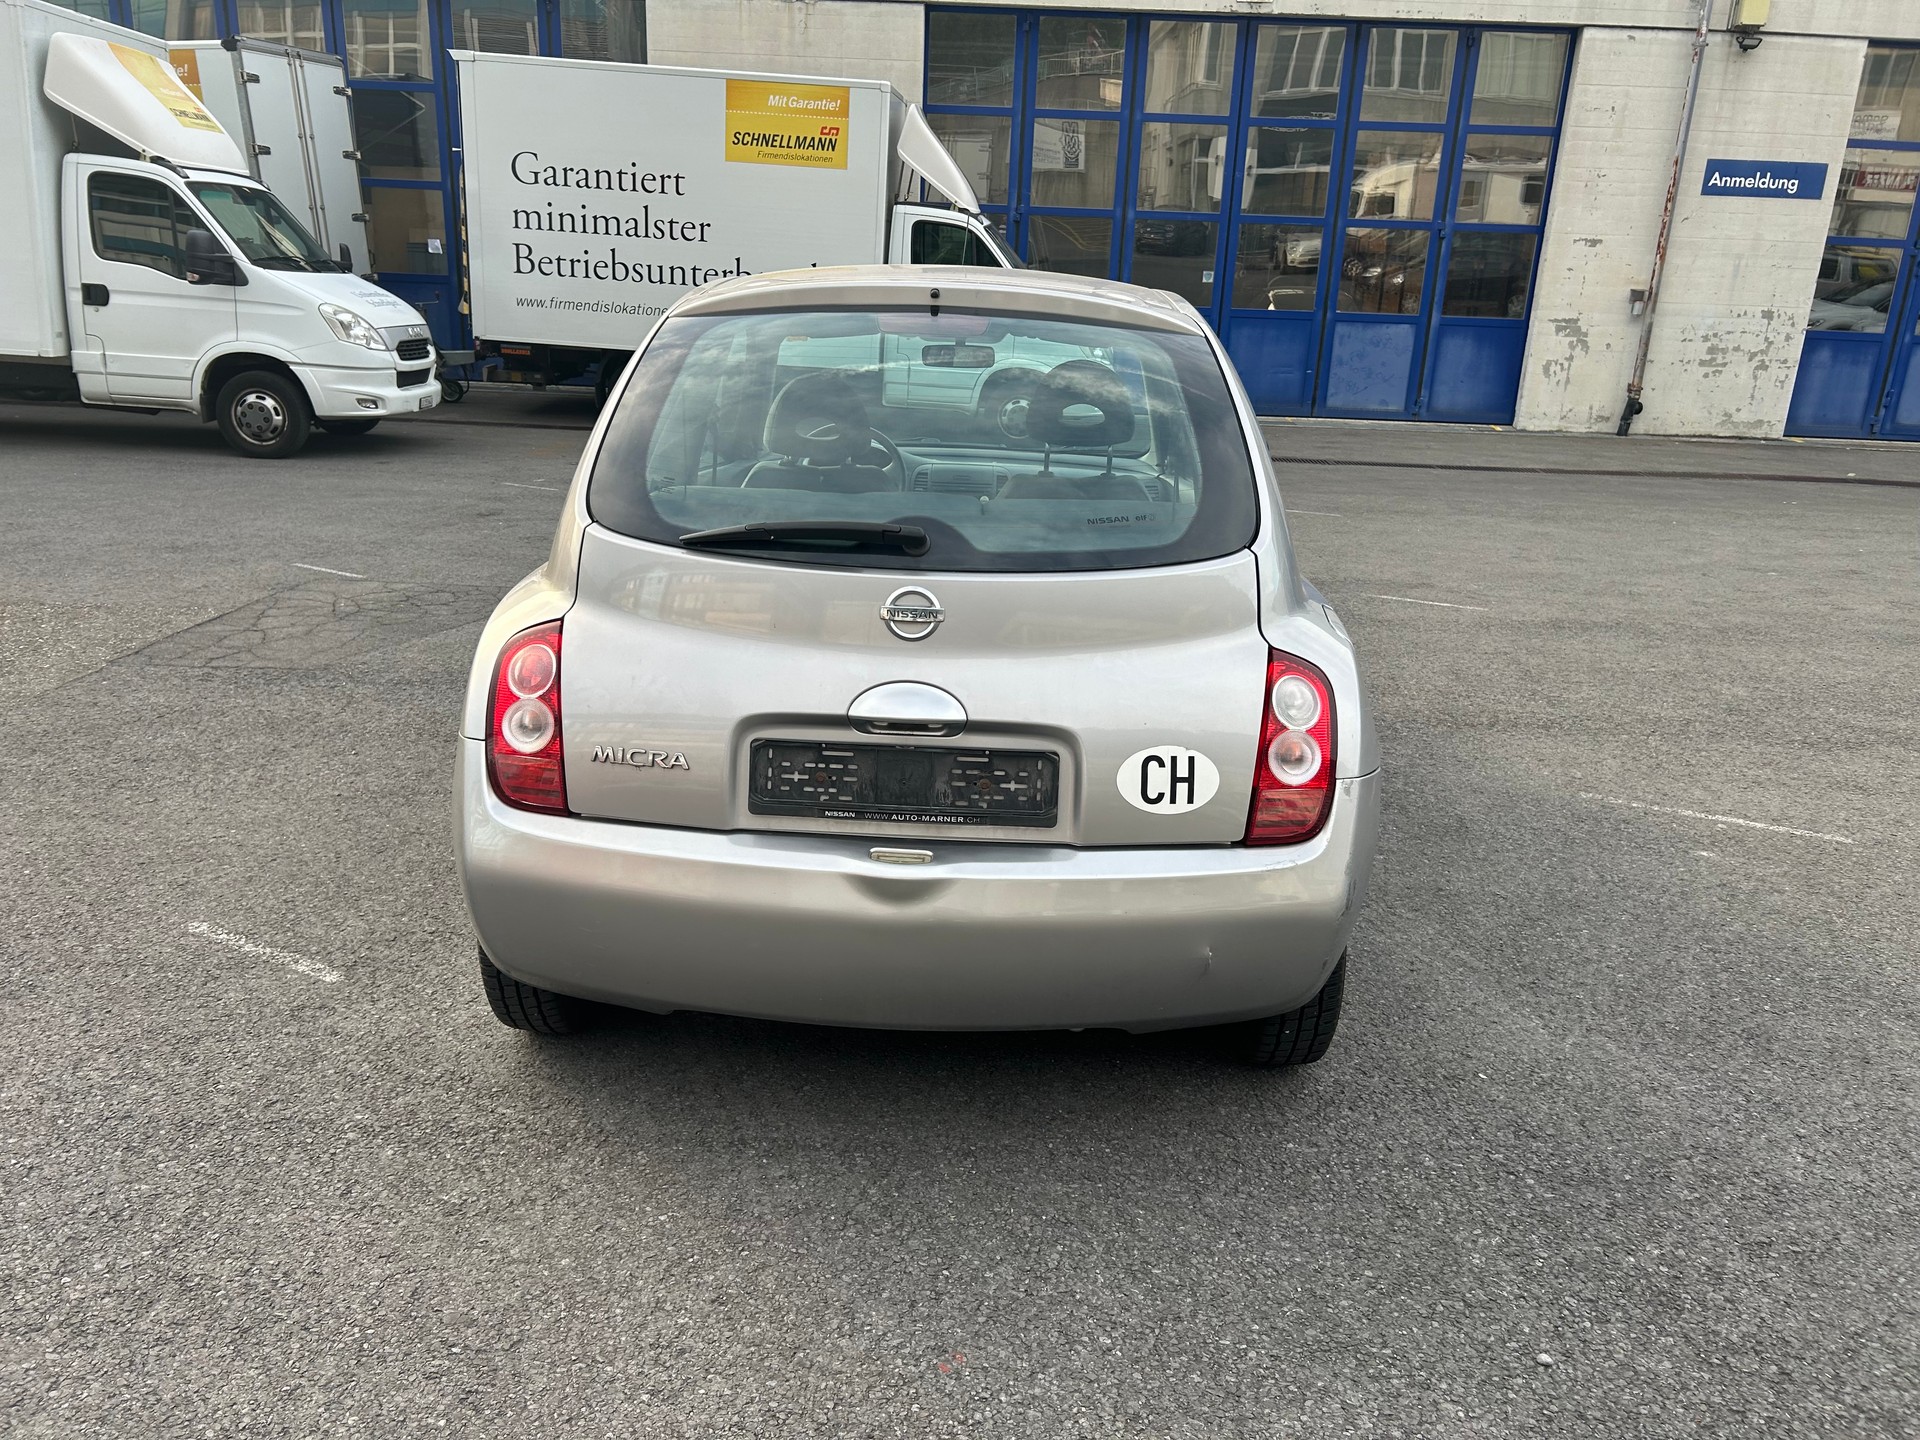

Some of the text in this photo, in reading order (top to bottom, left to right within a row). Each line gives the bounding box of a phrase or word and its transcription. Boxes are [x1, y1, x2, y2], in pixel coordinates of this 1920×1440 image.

[767, 95, 841, 111] Mit Garantie!
[732, 131, 838, 152] SCHNELLMANN
[757, 150, 833, 163] Firmendislokationen
[511, 151, 686, 196] Garantiert
[1708, 171, 1799, 194] Anmeldung
[512, 202, 712, 243] minimalster
[516, 296, 669, 317] www.firmendislokatione
[1087, 515, 1130, 525] NISSAN
[886, 609, 938, 619] NISSAN
[591, 745, 690, 770] MICRA
[1141, 754, 1195, 805] CH
[824, 810, 856, 818] NISSAN
